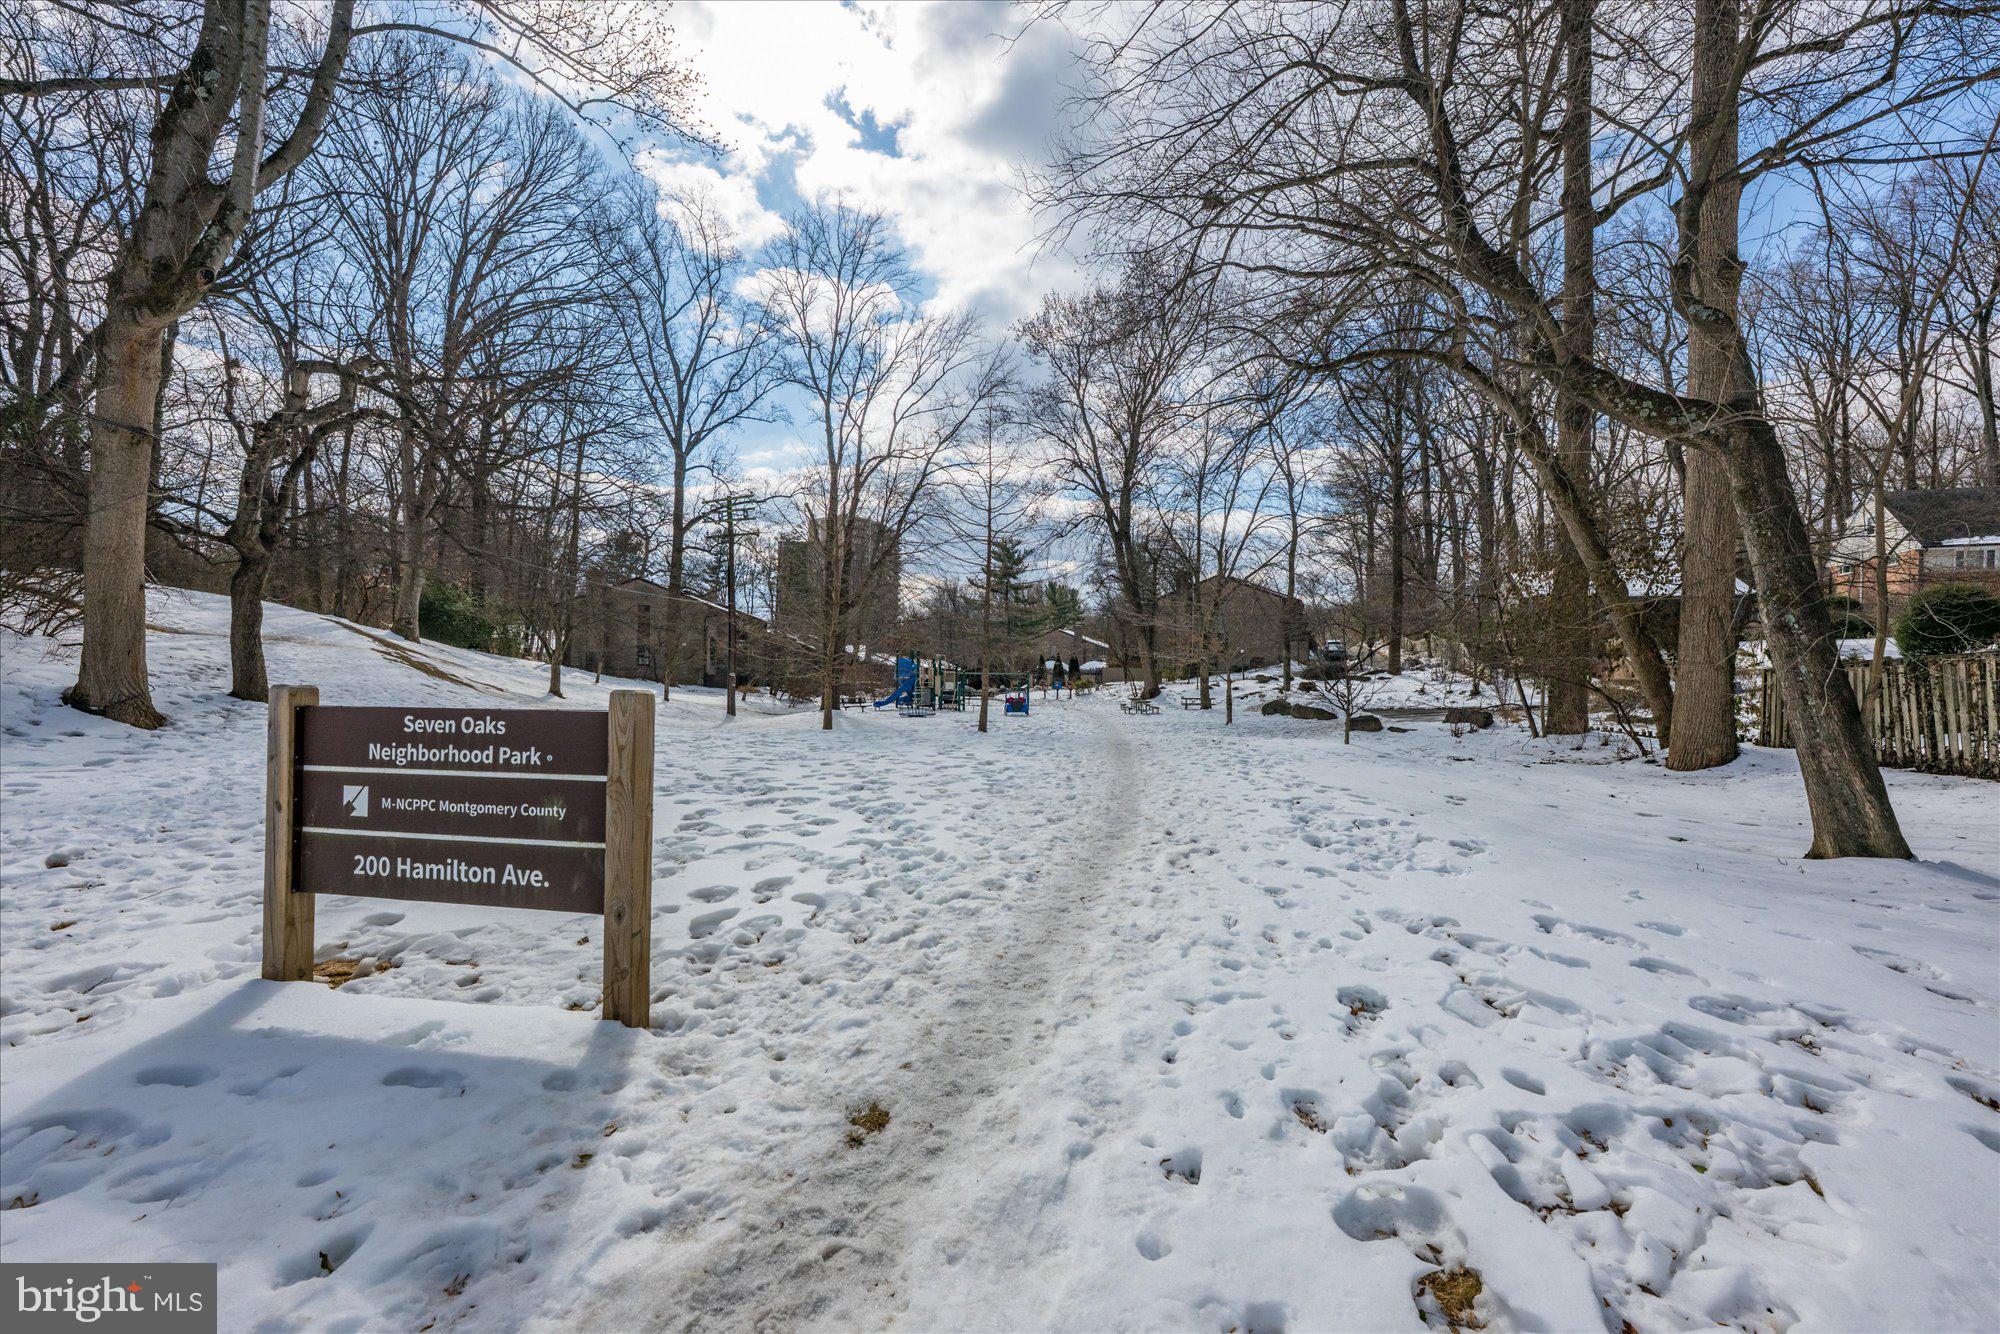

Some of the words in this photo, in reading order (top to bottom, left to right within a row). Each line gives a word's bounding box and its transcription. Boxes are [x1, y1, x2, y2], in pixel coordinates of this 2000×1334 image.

[403, 715, 457, 734] Seven
[461, 716, 506, 735] Oaks
[368, 742, 493, 766] Neighborhood
[499, 745, 542, 766] Park
[381, 797, 436, 812] M-NCPPC
[439, 800, 517, 817] Montgomery
[520, 803, 567, 821] County
[353, 854, 391, 877] 200
[396, 857, 496, 884] Hamilton
[501, 863, 550, 888] Ave.
